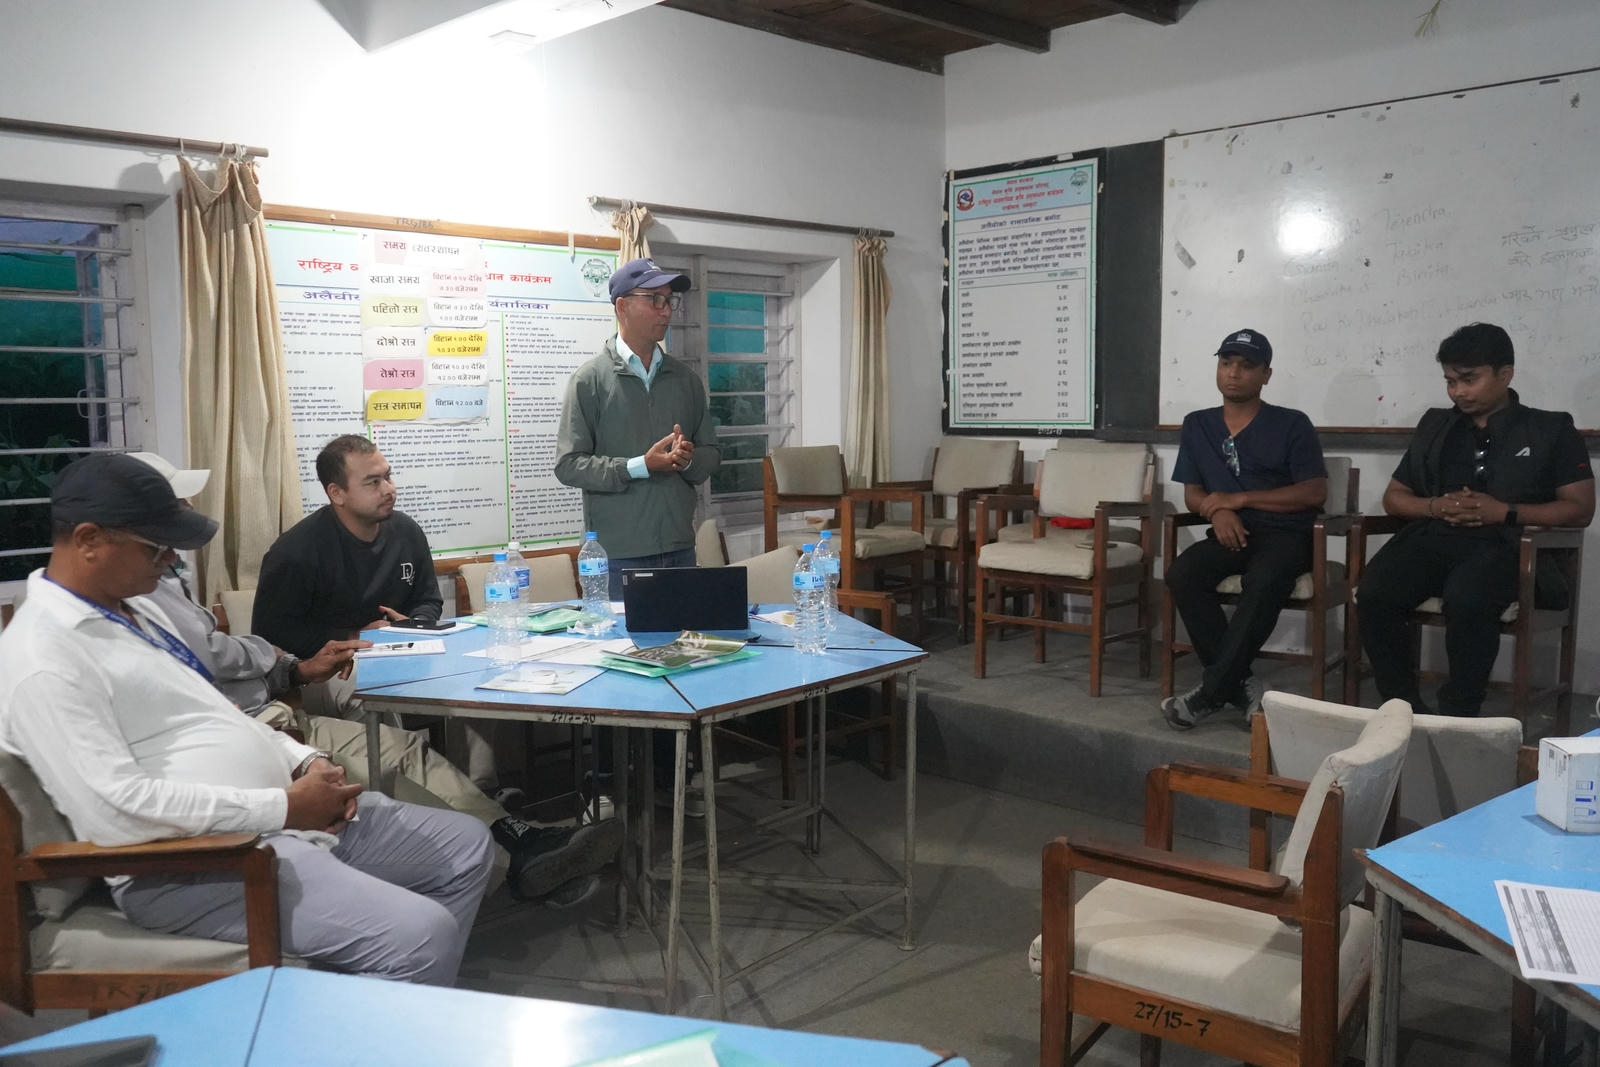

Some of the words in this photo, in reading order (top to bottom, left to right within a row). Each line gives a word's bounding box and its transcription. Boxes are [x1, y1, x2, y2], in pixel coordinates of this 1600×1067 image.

[383, 240, 407, 251] समय
[297, 257, 344, 273] राष्ट्रिय
[368, 275, 395, 284] खाजा
[397, 276, 420, 284] समय
[510, 273, 553, 284] कार्यक्रम
[372, 303, 399, 314] पहिलो
[402, 305, 418, 314] सत्र
[377, 336, 399, 347] दोश्रो
[400, 338, 416, 346] सत्र
[380, 368, 399, 378] तेश्रो
[400, 369, 416, 378] सत्र
[373, 402, 389, 411] सत्र
[391, 402, 423, 411] समापन
[434, 398, 454, 406] बिहान
[1135, 1001, 1211, 1038] 27/15-7
